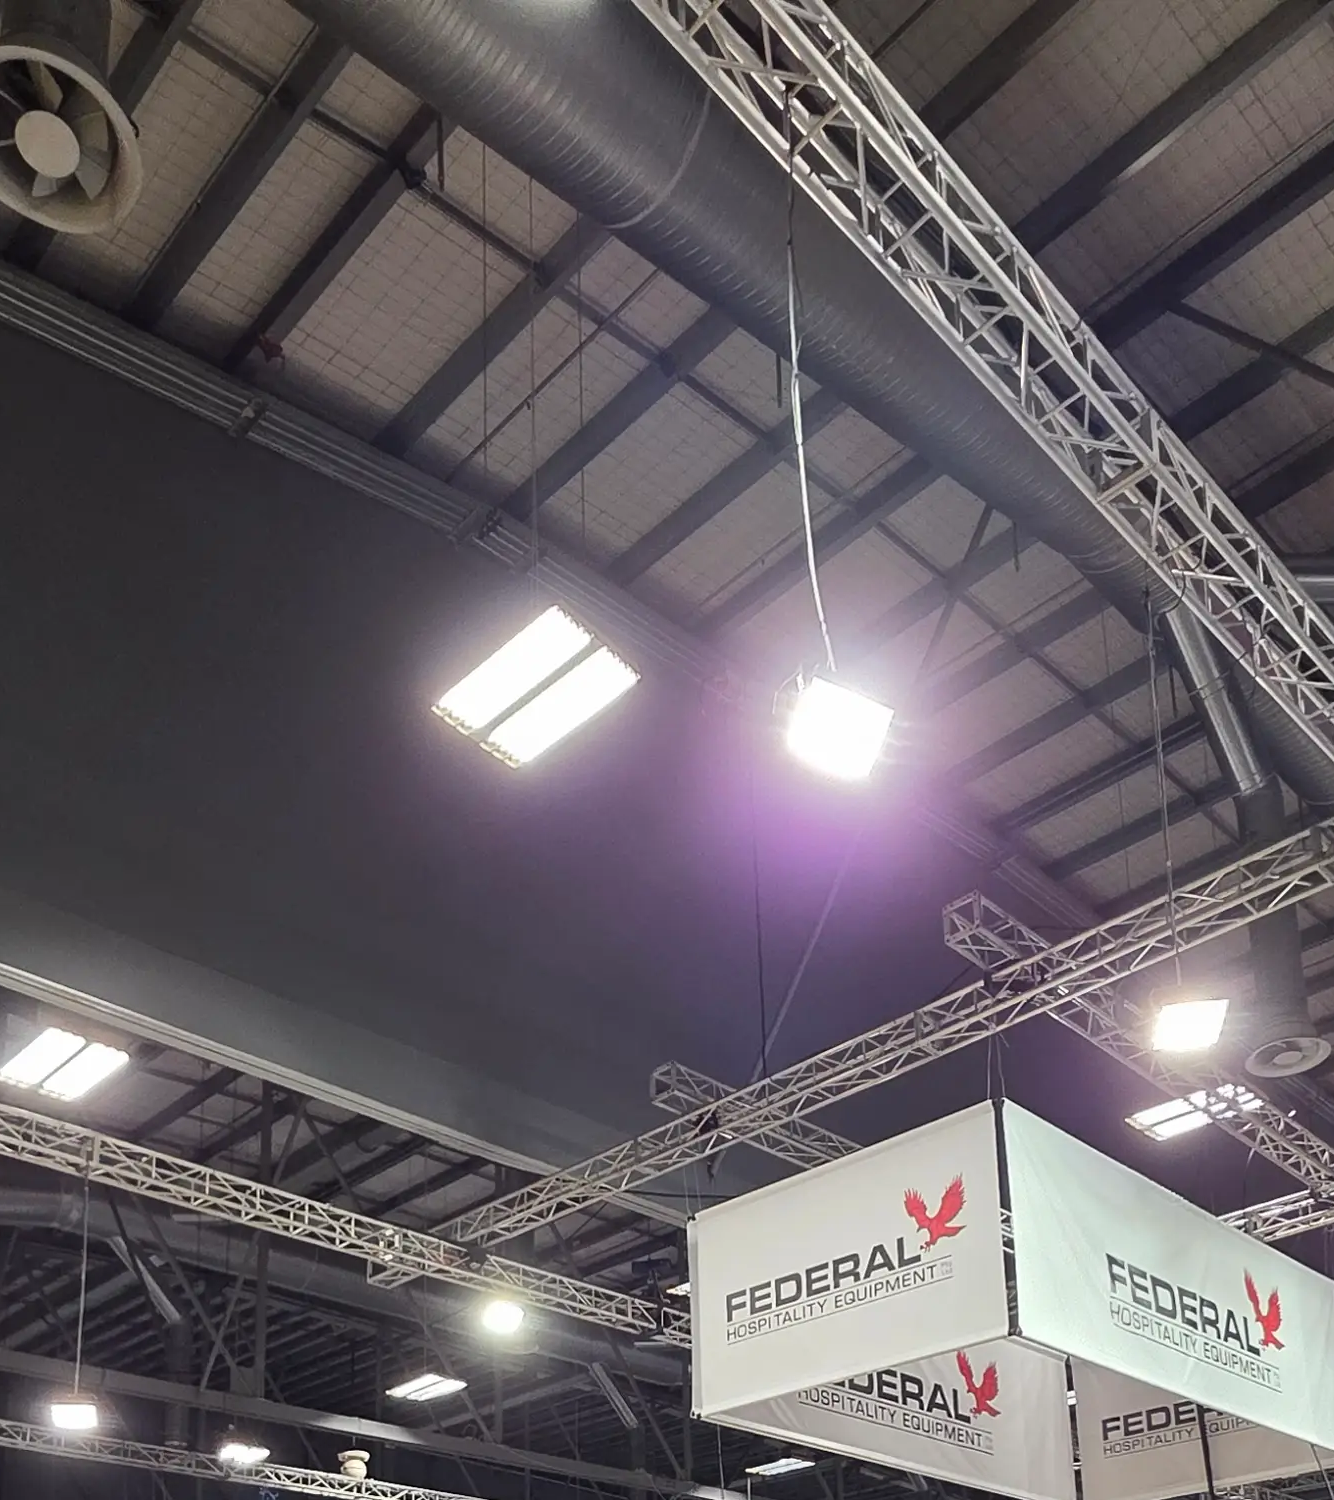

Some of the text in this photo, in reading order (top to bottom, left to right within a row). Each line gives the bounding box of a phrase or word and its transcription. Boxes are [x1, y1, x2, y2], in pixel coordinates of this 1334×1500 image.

[726, 1237, 921, 1323] FEDERAL
[727, 1298, 829, 1341] HOSPITALITY
[834, 1264, 938, 1309] EQUIPMENT
[1105, 1252, 1262, 1356] FEDERAL
[1109, 1301, 1198, 1354] HOSPITALITY
[1203, 1341, 1271, 1383] EQUIPMENT
[833, 1369, 971, 1424] DERAL
[903, 1412, 983, 1447] EQUIPMENT
[1103, 1428, 1195, 1456] HOSPITALITY
